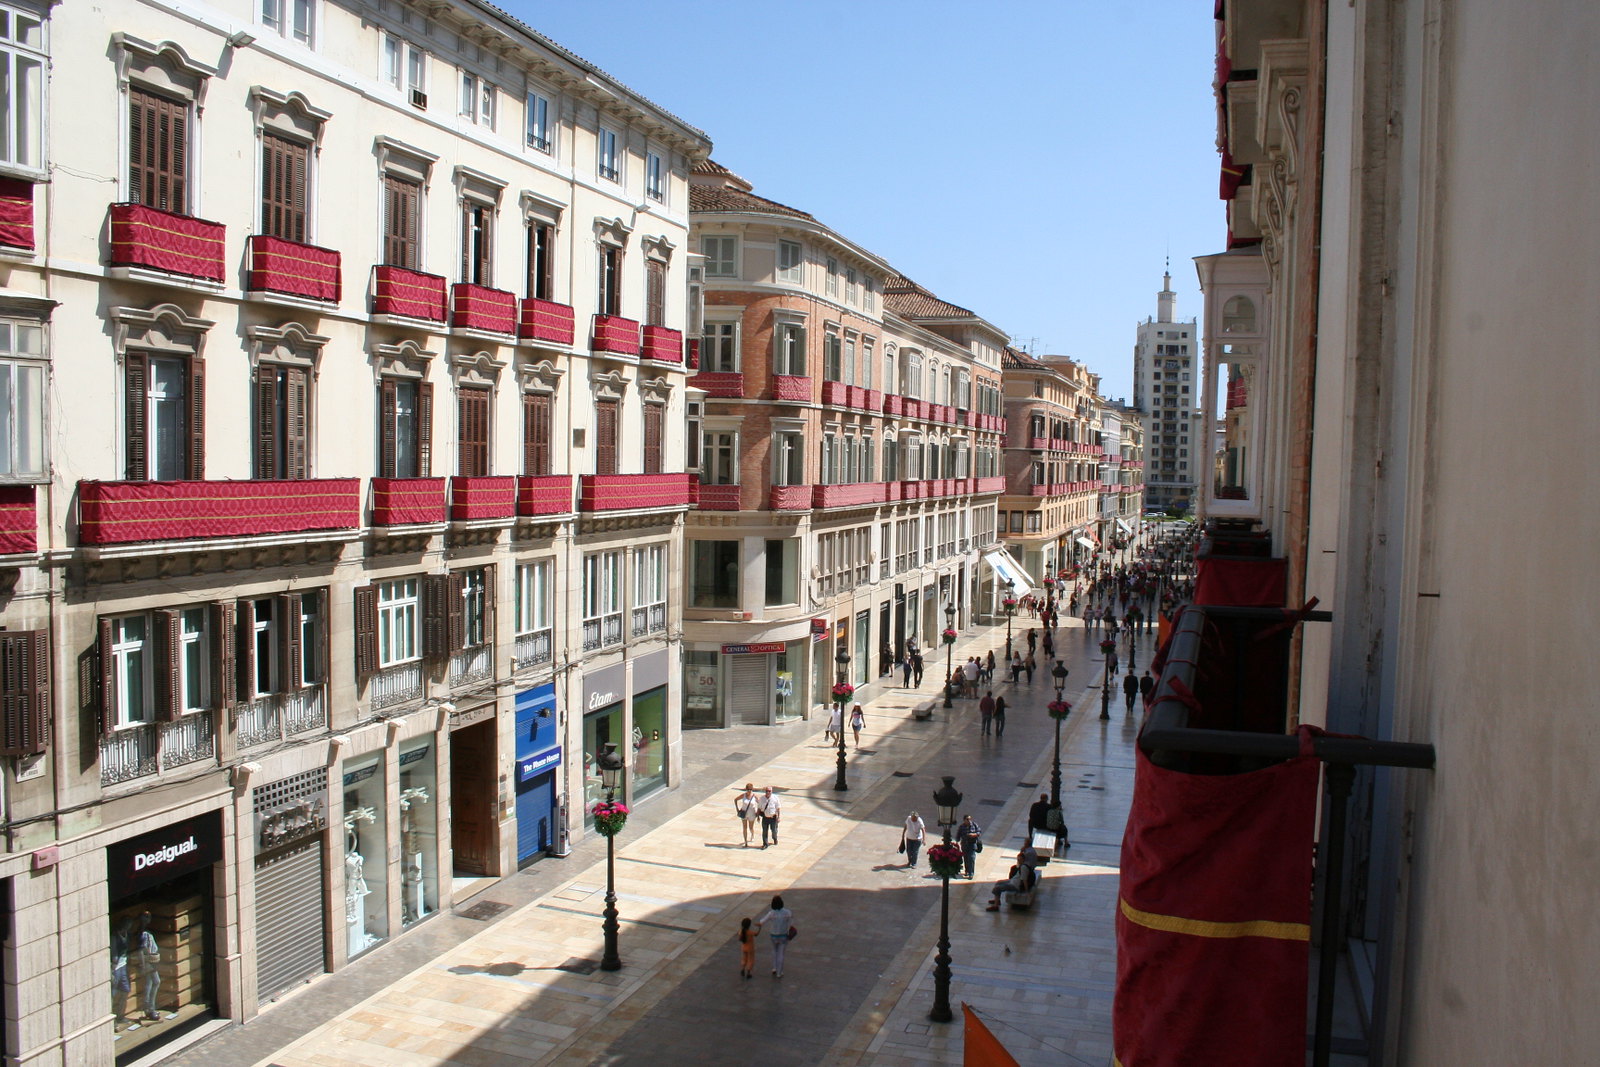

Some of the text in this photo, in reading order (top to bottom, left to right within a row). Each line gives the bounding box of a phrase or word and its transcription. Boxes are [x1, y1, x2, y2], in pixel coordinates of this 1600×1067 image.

[725, 645, 751, 653] GENERAL
[588, 691, 613, 710] Etam
[523, 752, 560, 773] The Phone House
[134, 835, 195, 871] Desigual
